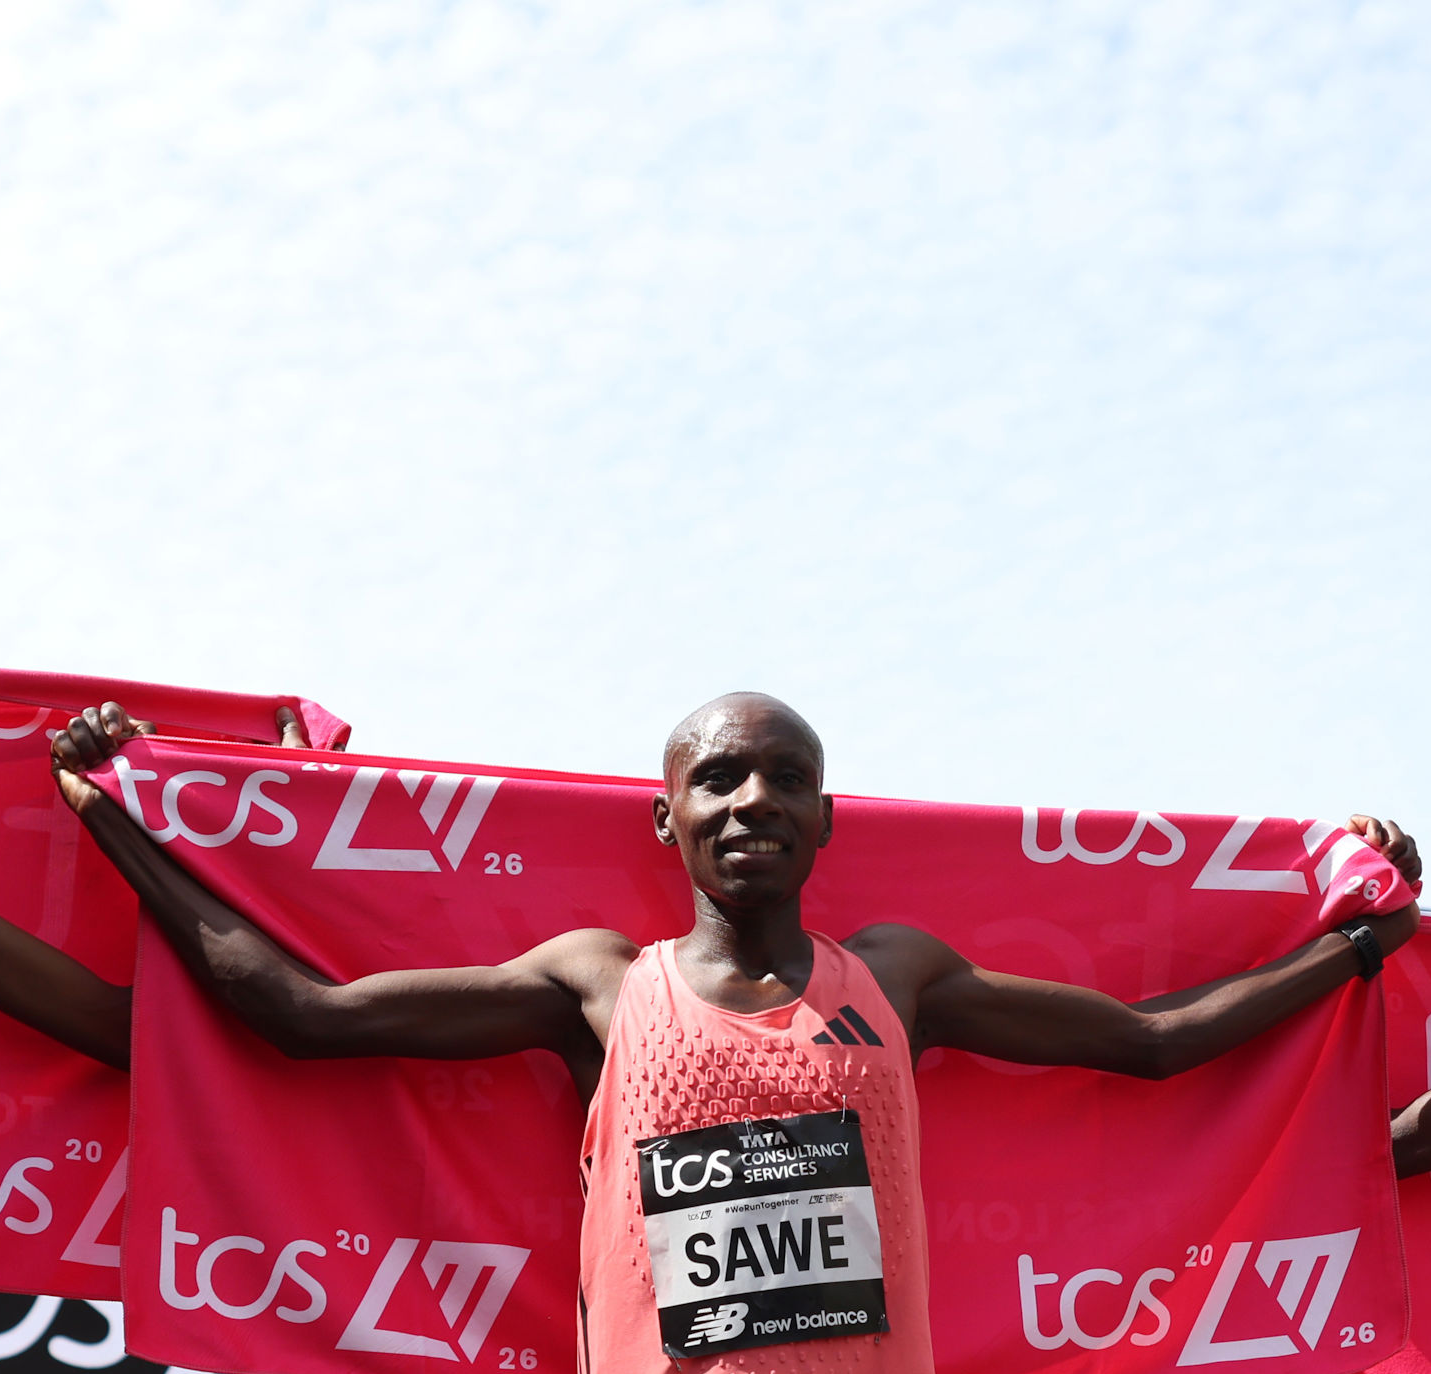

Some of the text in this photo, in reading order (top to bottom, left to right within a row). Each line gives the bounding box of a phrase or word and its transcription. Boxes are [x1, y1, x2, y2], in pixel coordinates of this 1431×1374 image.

[112, 757, 298, 847] tcs
[484, 853, 524, 876] 26
[1344, 876, 1382, 901] 26
[65, 1139, 101, 1162] 20
[652, 1131, 788, 1197] tcs TATA
[741, 1142, 850, 1167] CONSULTANCY
[744, 1161, 818, 1184] SERVICES
[725, 1198, 800, 1214] #WeRunTogether
[685, 1215, 849, 1288] SAWE
[159, 1207, 327, 1324] tcs
[336, 1229, 370, 1255] 20
[499, 1347, 538, 1370] 26
[1017, 1254, 1176, 1351] tcs
[1184, 1244, 1214, 1268] 20
[1339, 1322, 1376, 1348] 26
[753, 1318, 791, 1336] new
[796, 1308, 868, 1330] balance
